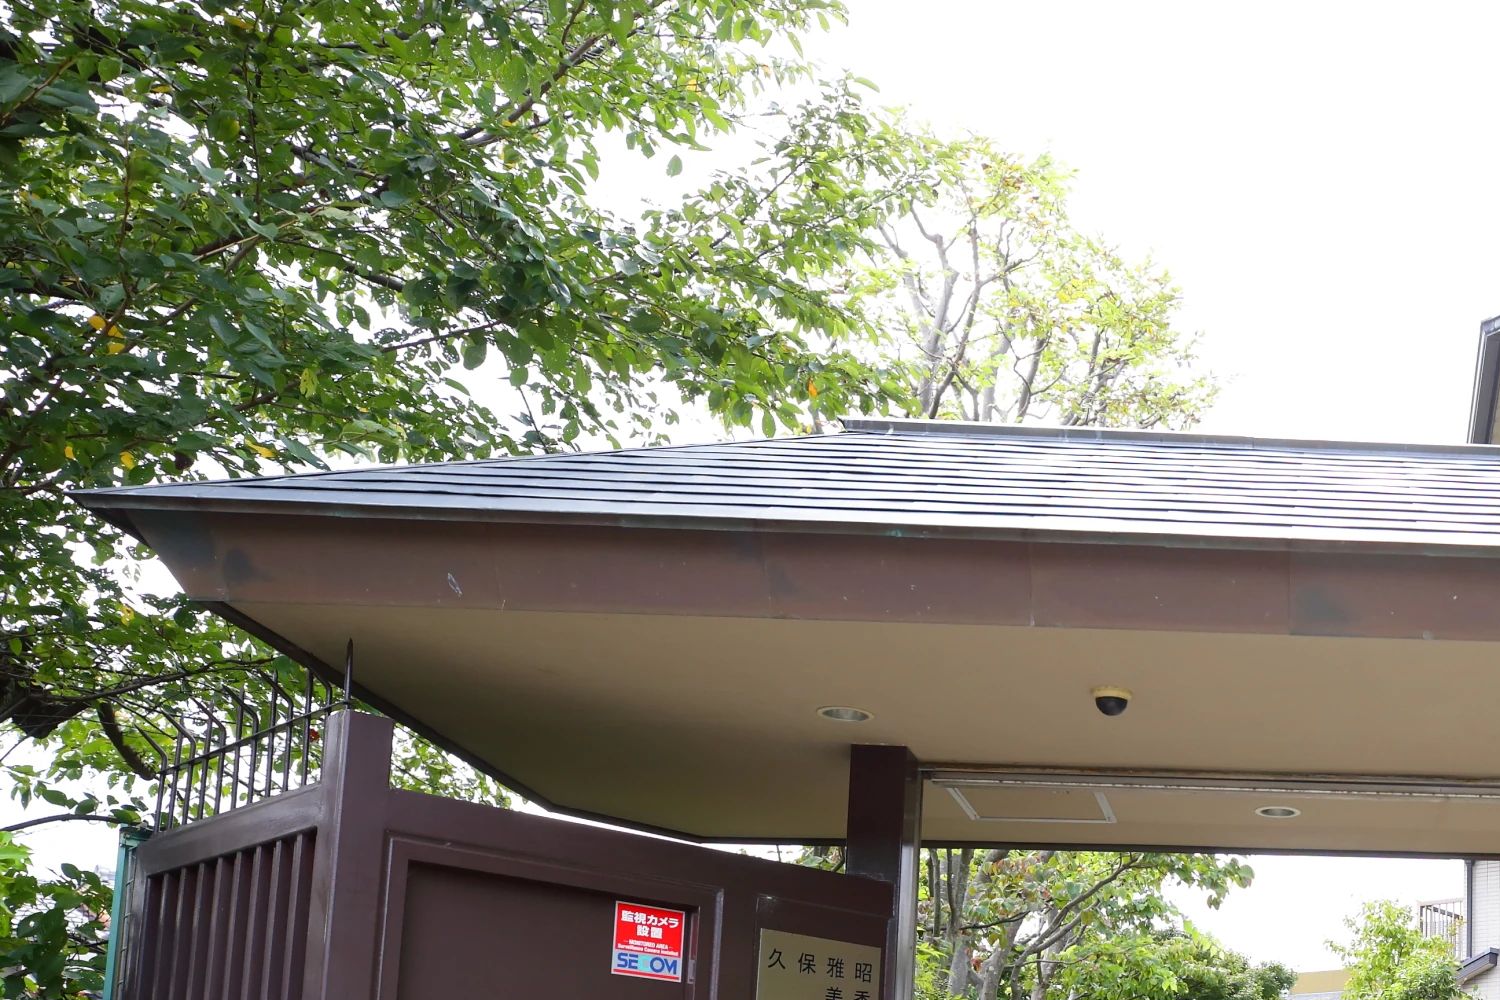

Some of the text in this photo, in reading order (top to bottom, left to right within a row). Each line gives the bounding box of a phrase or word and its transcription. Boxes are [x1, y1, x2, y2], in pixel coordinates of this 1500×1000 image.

[621, 910, 679, 928] 監視カメラ
[636, 925, 662, 939] 設置
